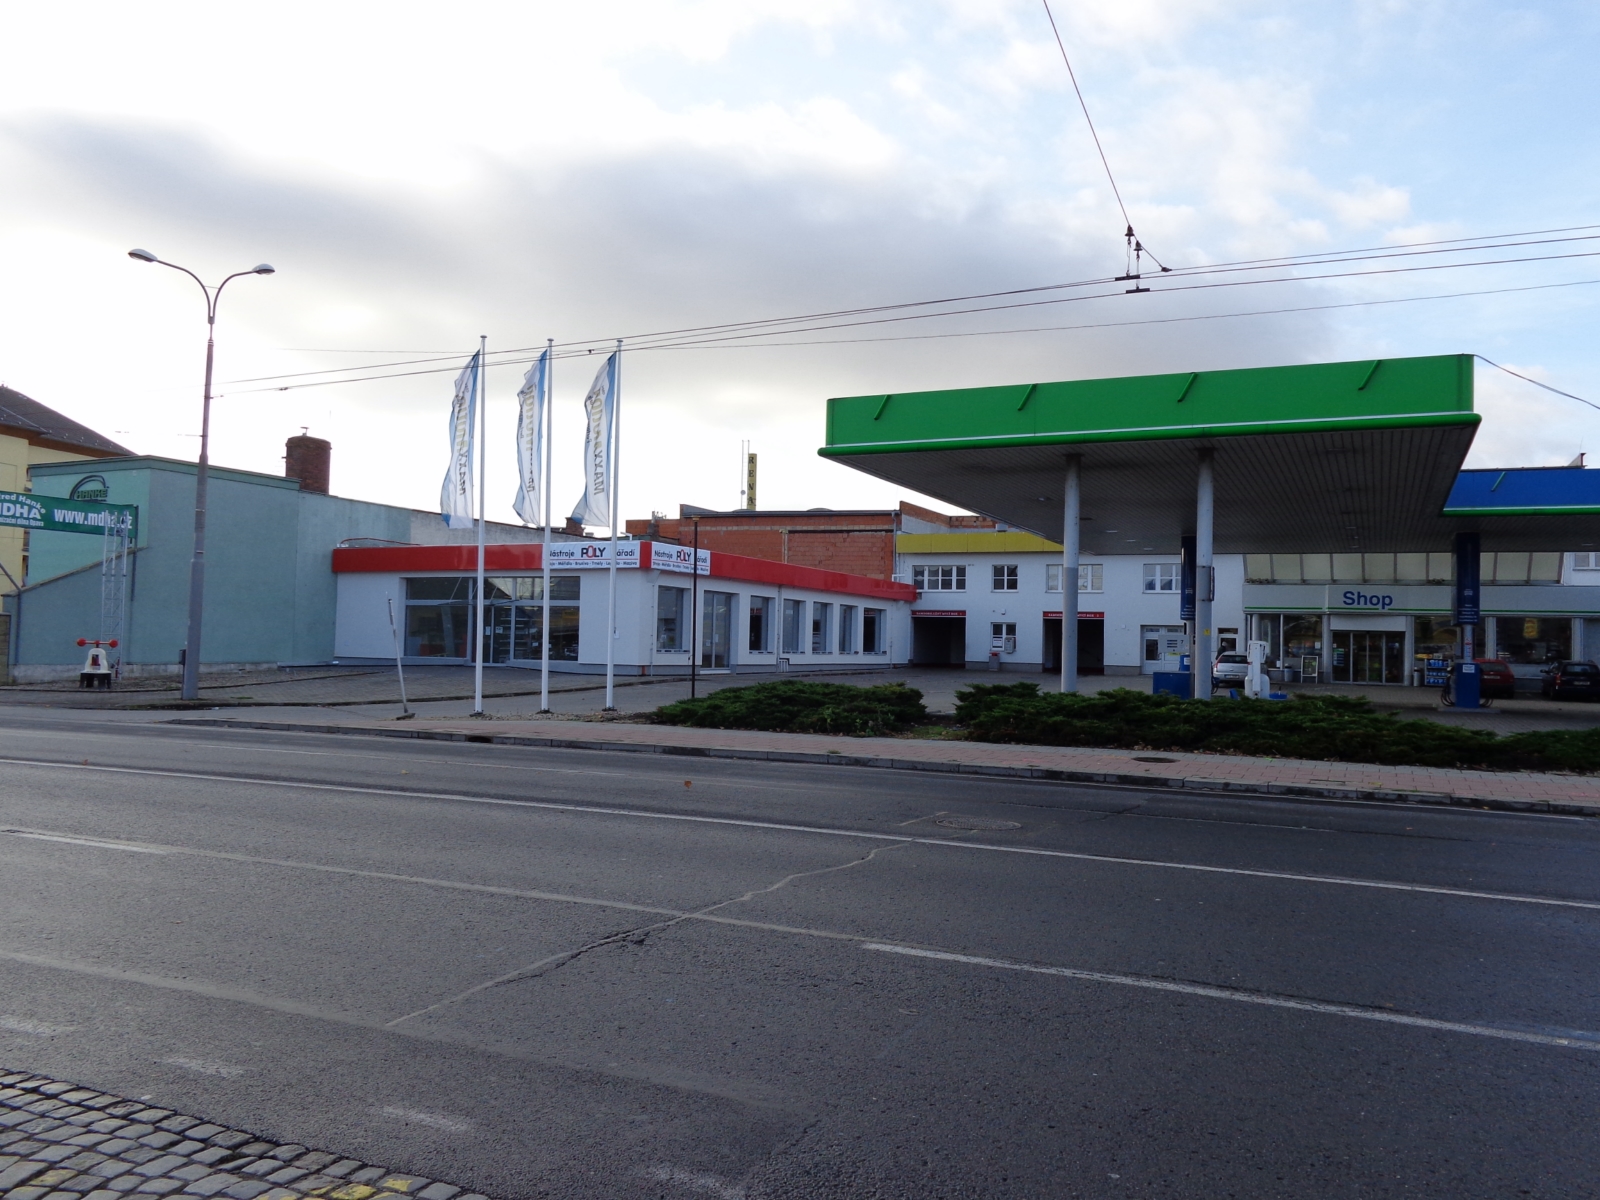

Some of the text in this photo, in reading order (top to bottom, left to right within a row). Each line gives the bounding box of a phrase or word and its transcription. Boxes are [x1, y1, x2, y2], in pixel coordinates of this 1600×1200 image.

[76, 488, 108, 499] HANKE
[580, 545, 606, 558] POLY
[616, 548, 636, 557] ářadí
[654, 549, 673, 560] Nástroje
[676, 549, 692, 562] POLY
[1342, 590, 1393, 610] Shop
